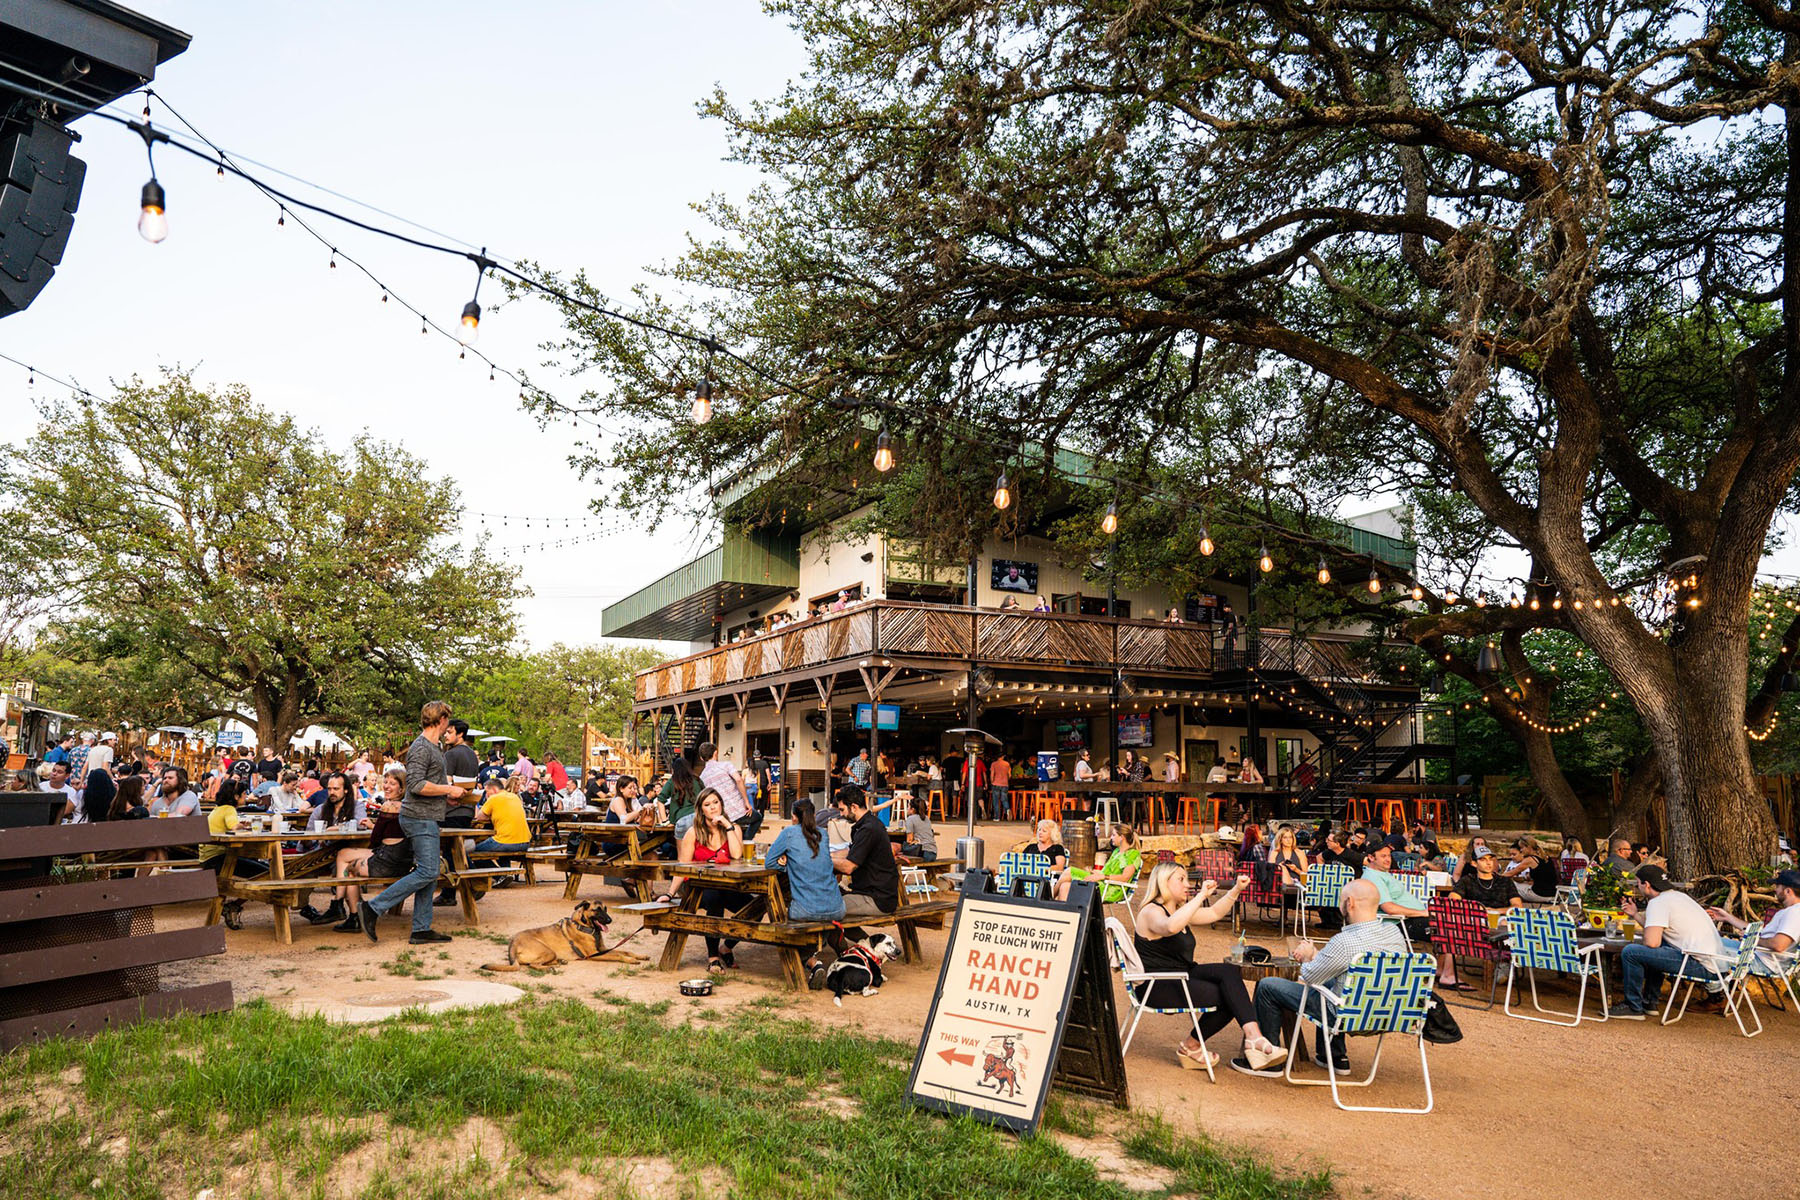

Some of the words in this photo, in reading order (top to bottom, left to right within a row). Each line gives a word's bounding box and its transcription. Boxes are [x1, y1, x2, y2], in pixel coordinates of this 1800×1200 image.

[973, 920, 999, 932] STOP
[1000, 924, 1036, 938] EATING
[1038, 929, 1063, 941] SHIT
[972, 932, 992, 943] FOR
[994, 935, 1028, 948] LUNCH
[1030, 940, 1058, 953] WITH
[966, 949, 1052, 979] RANCH
[968, 972, 1040, 1001] HAND
[965, 998, 1011, 1015] AUSTIN,
[1017, 1007, 1031, 1018] TX
[940, 1031, 959, 1043] THIS
[961, 1036, 980, 1048] WAY
